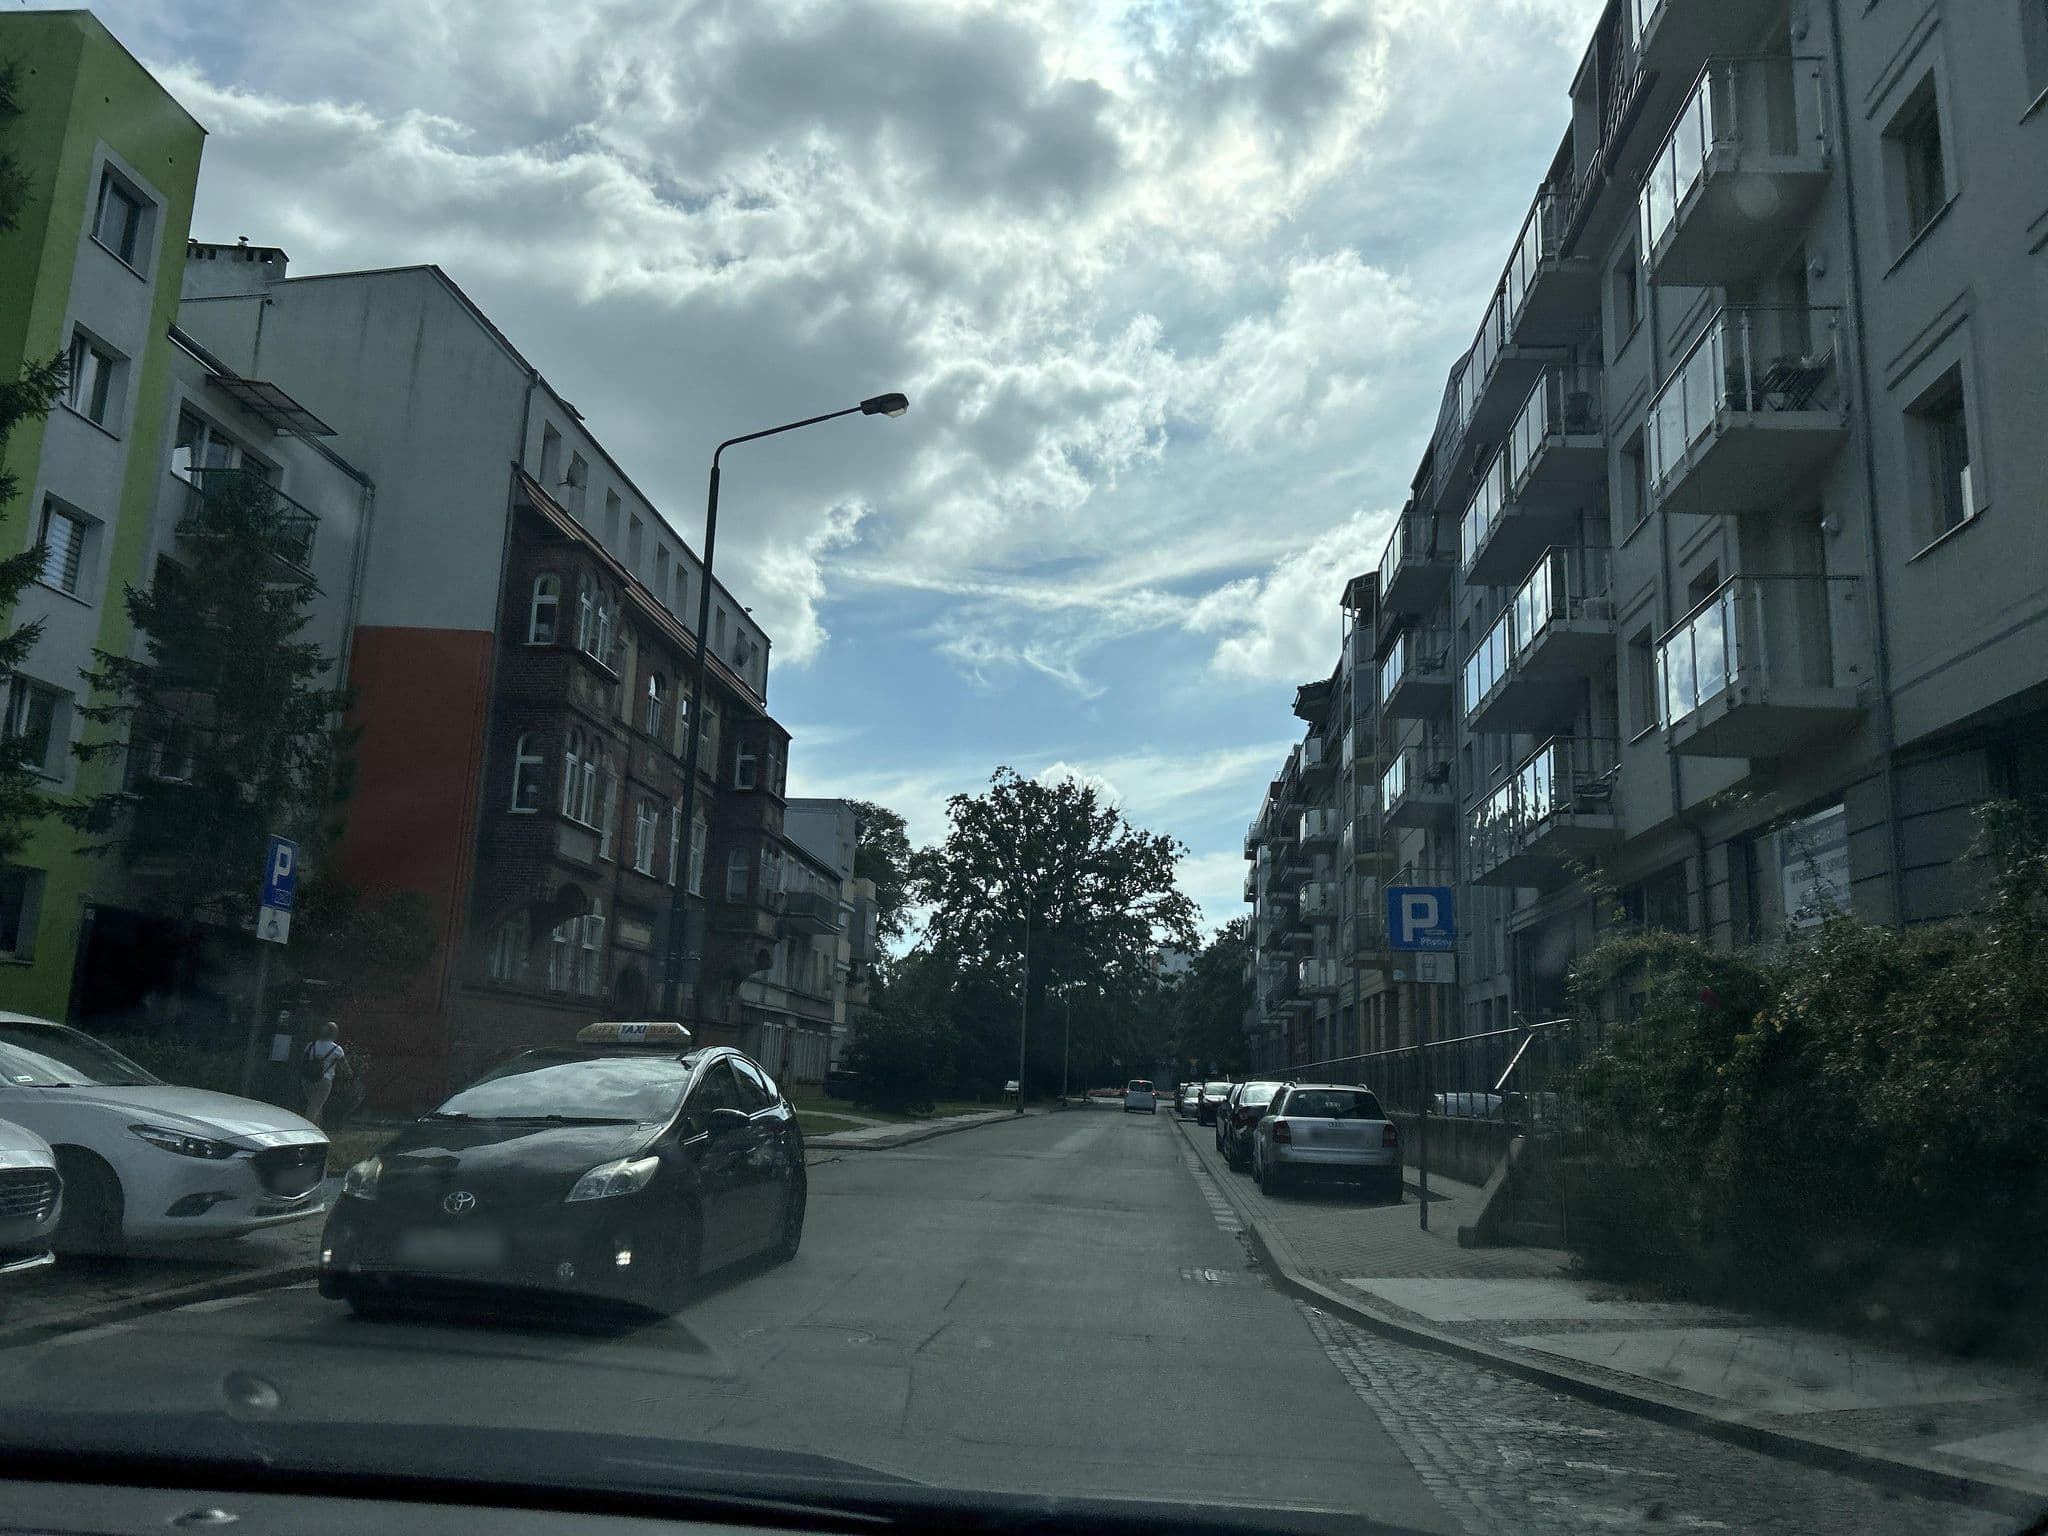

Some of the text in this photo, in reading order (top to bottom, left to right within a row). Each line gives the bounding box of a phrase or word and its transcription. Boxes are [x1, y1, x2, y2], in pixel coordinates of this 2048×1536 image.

[272, 843, 292, 886] P
[1401, 894, 1439, 942] P
[621, 1024, 648, 1034] TAXI
